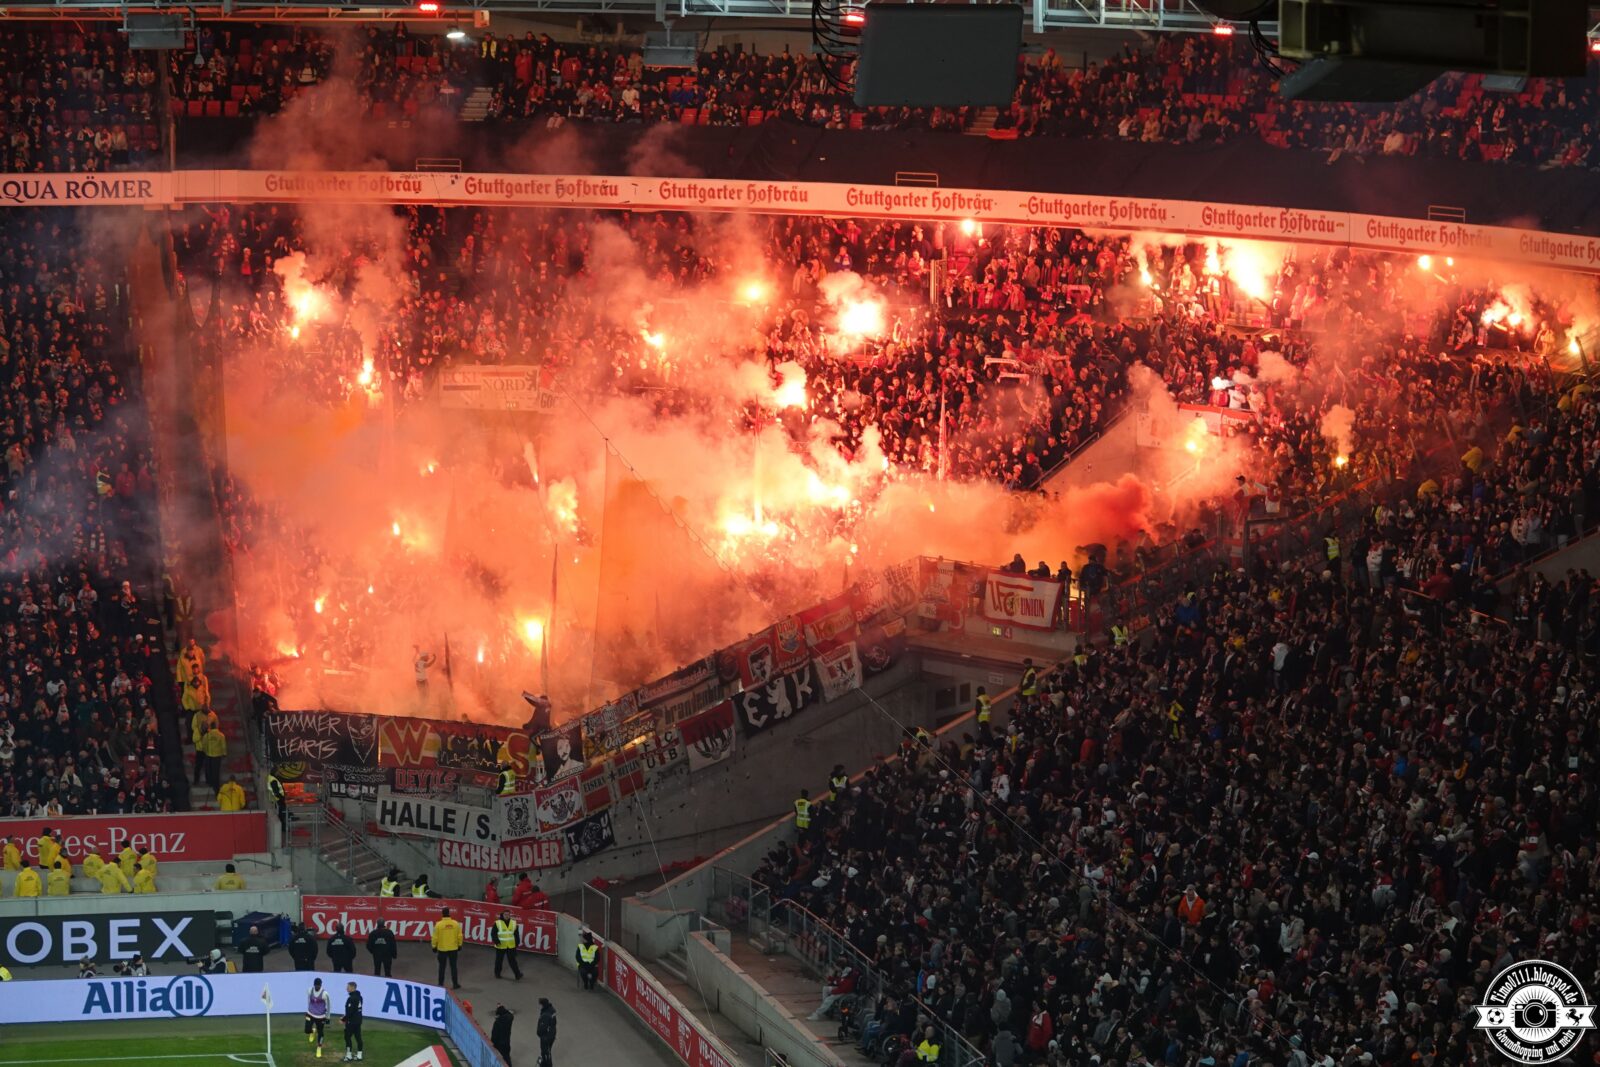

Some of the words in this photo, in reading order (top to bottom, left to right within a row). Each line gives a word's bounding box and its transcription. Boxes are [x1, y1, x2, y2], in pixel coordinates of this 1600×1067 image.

[0, 180, 58, 202] QUA
[65, 176, 153, 199] RÖMER
[464, 177, 551, 198] Stuttgarter
[555, 178, 619, 199] Hofbräu
[659, 181, 744, 202] Stuttgarter
[747, 182, 809, 205] Hofbräu
[846, 187, 928, 211] Stuttgarter
[932, 190, 993, 212] Hofbräu
[1028, 195, 1106, 220] Stuttgarter
[1108, 198, 1167, 222] Hofbräu
[1279, 208, 1336, 234] Hofbräu
[1366, 218, 1436, 244] Stuttgarter
[1519, 233, 1586, 261] Stuttgarter
[482, 378, 526, 391] NORD
[1020, 598, 1045, 618] UNION
[268, 713, 342, 736] HAMMER
[277, 737, 339, 760] HEARTS
[381, 720, 433, 767] W
[506, 732, 532, 778] S
[395, 768, 457, 791] DEVILS
[380, 800, 457, 834] HALLE
[476, 813, 497, 841] S.
[441, 839, 561, 870] SACHSENADLER
[6, 917, 194, 963] OBEX
[312, 911, 552, 951] Schwarzldlch
